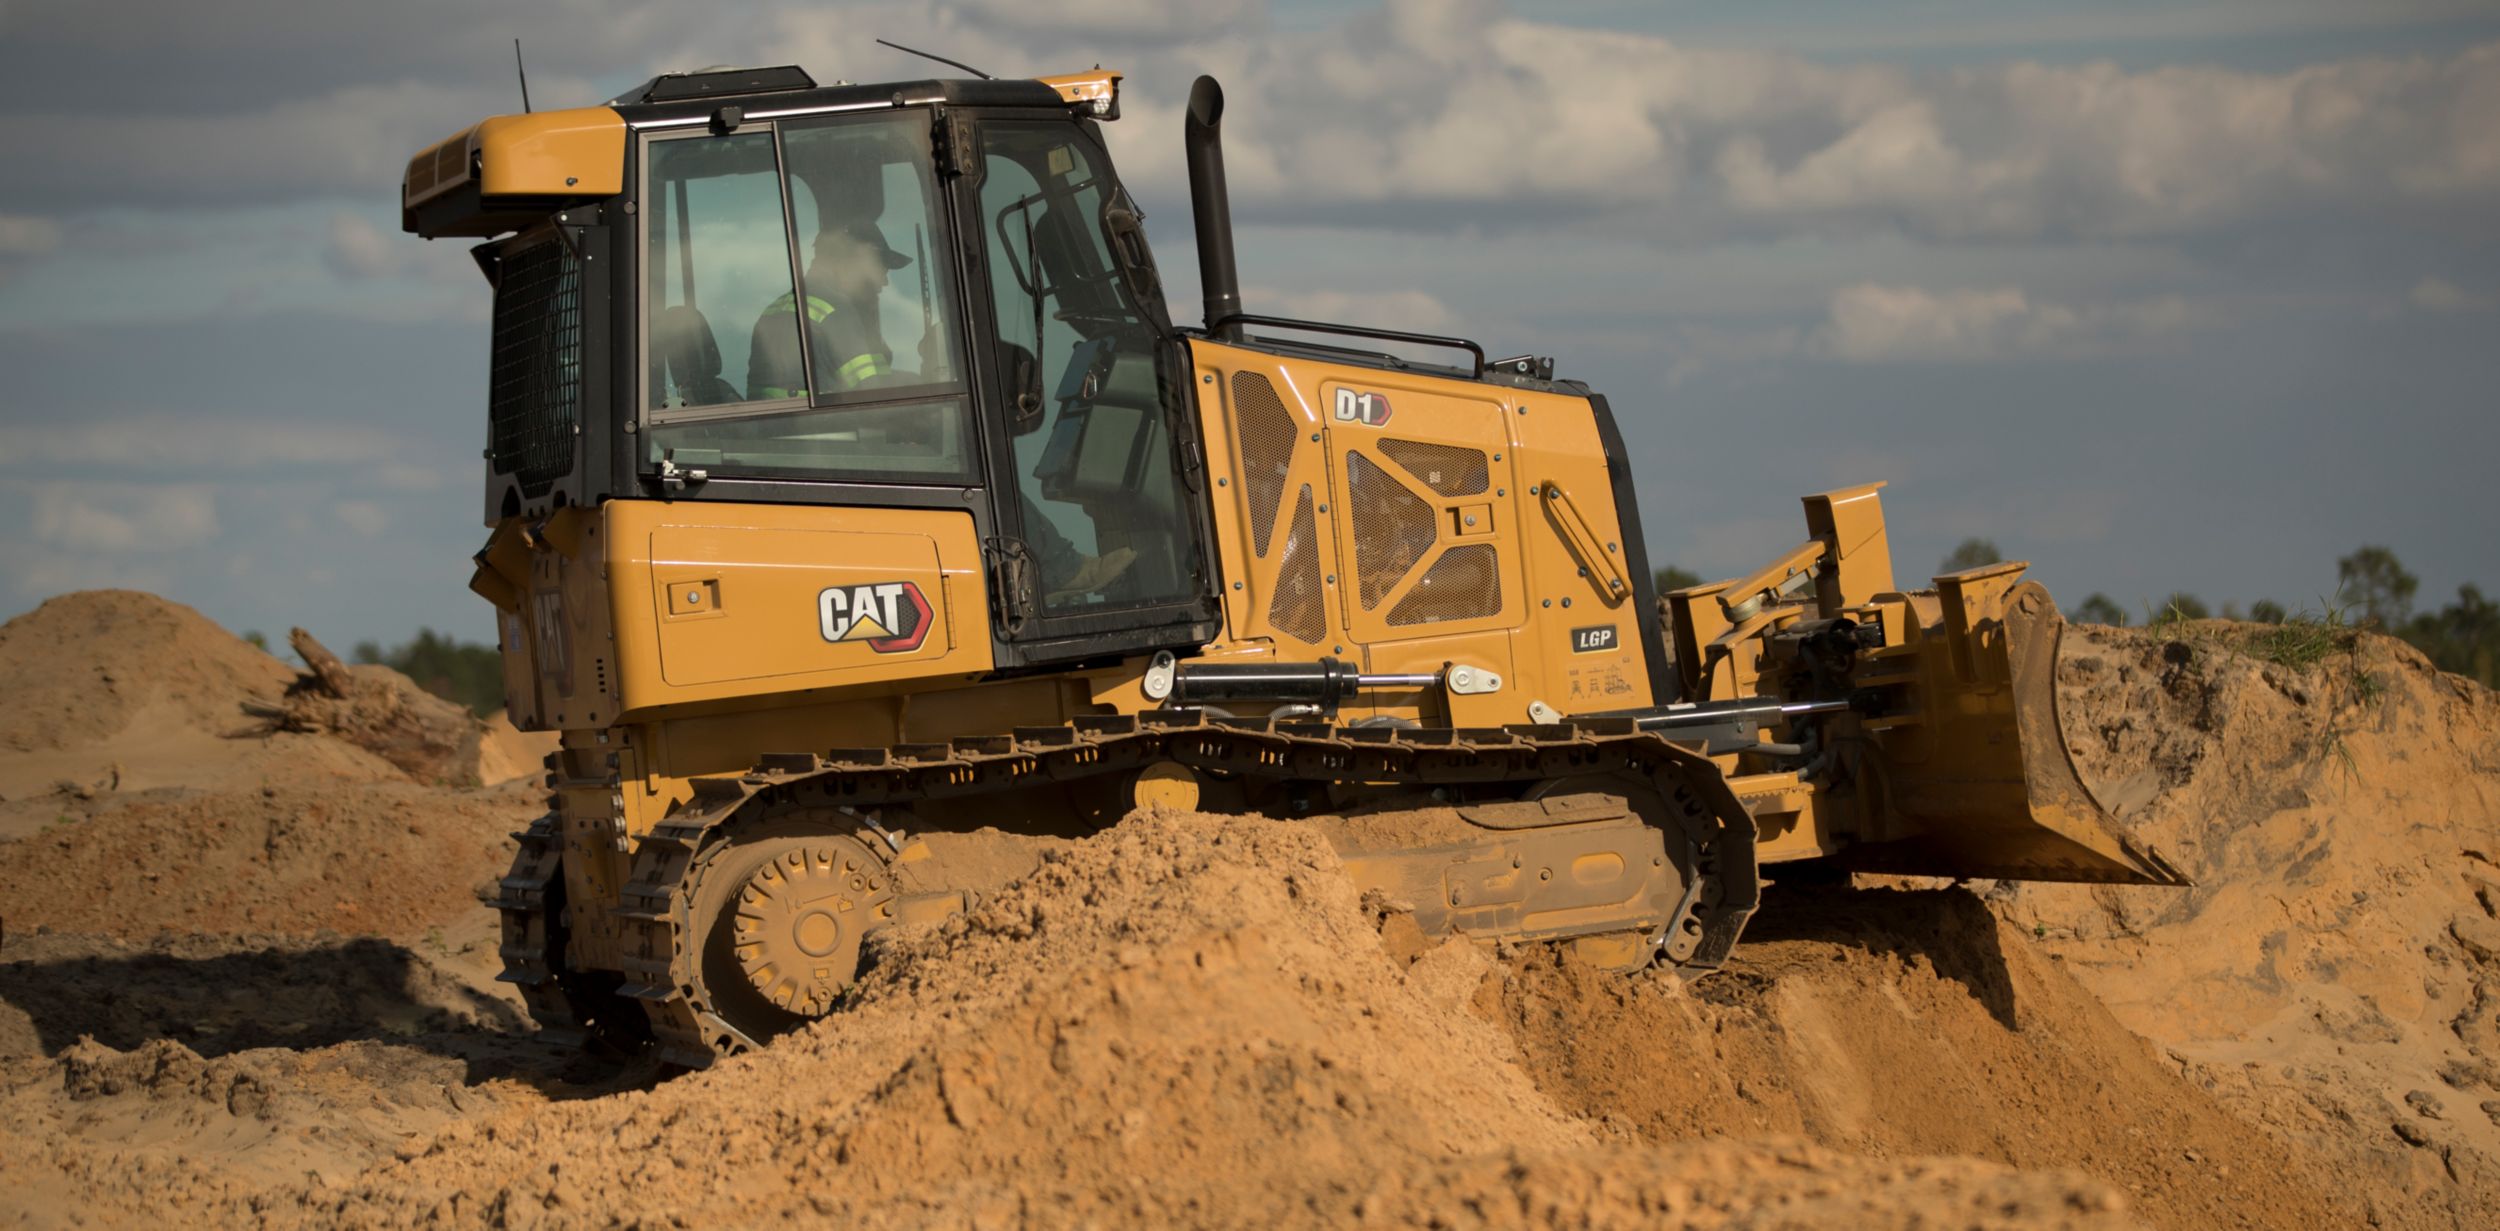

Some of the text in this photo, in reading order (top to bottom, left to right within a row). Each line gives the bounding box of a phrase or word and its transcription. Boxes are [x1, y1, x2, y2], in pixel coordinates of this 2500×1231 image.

[1336, 388, 1372, 424] D1
[819, 583, 903, 641] CAT
[1580, 629, 1611, 648] LGP
